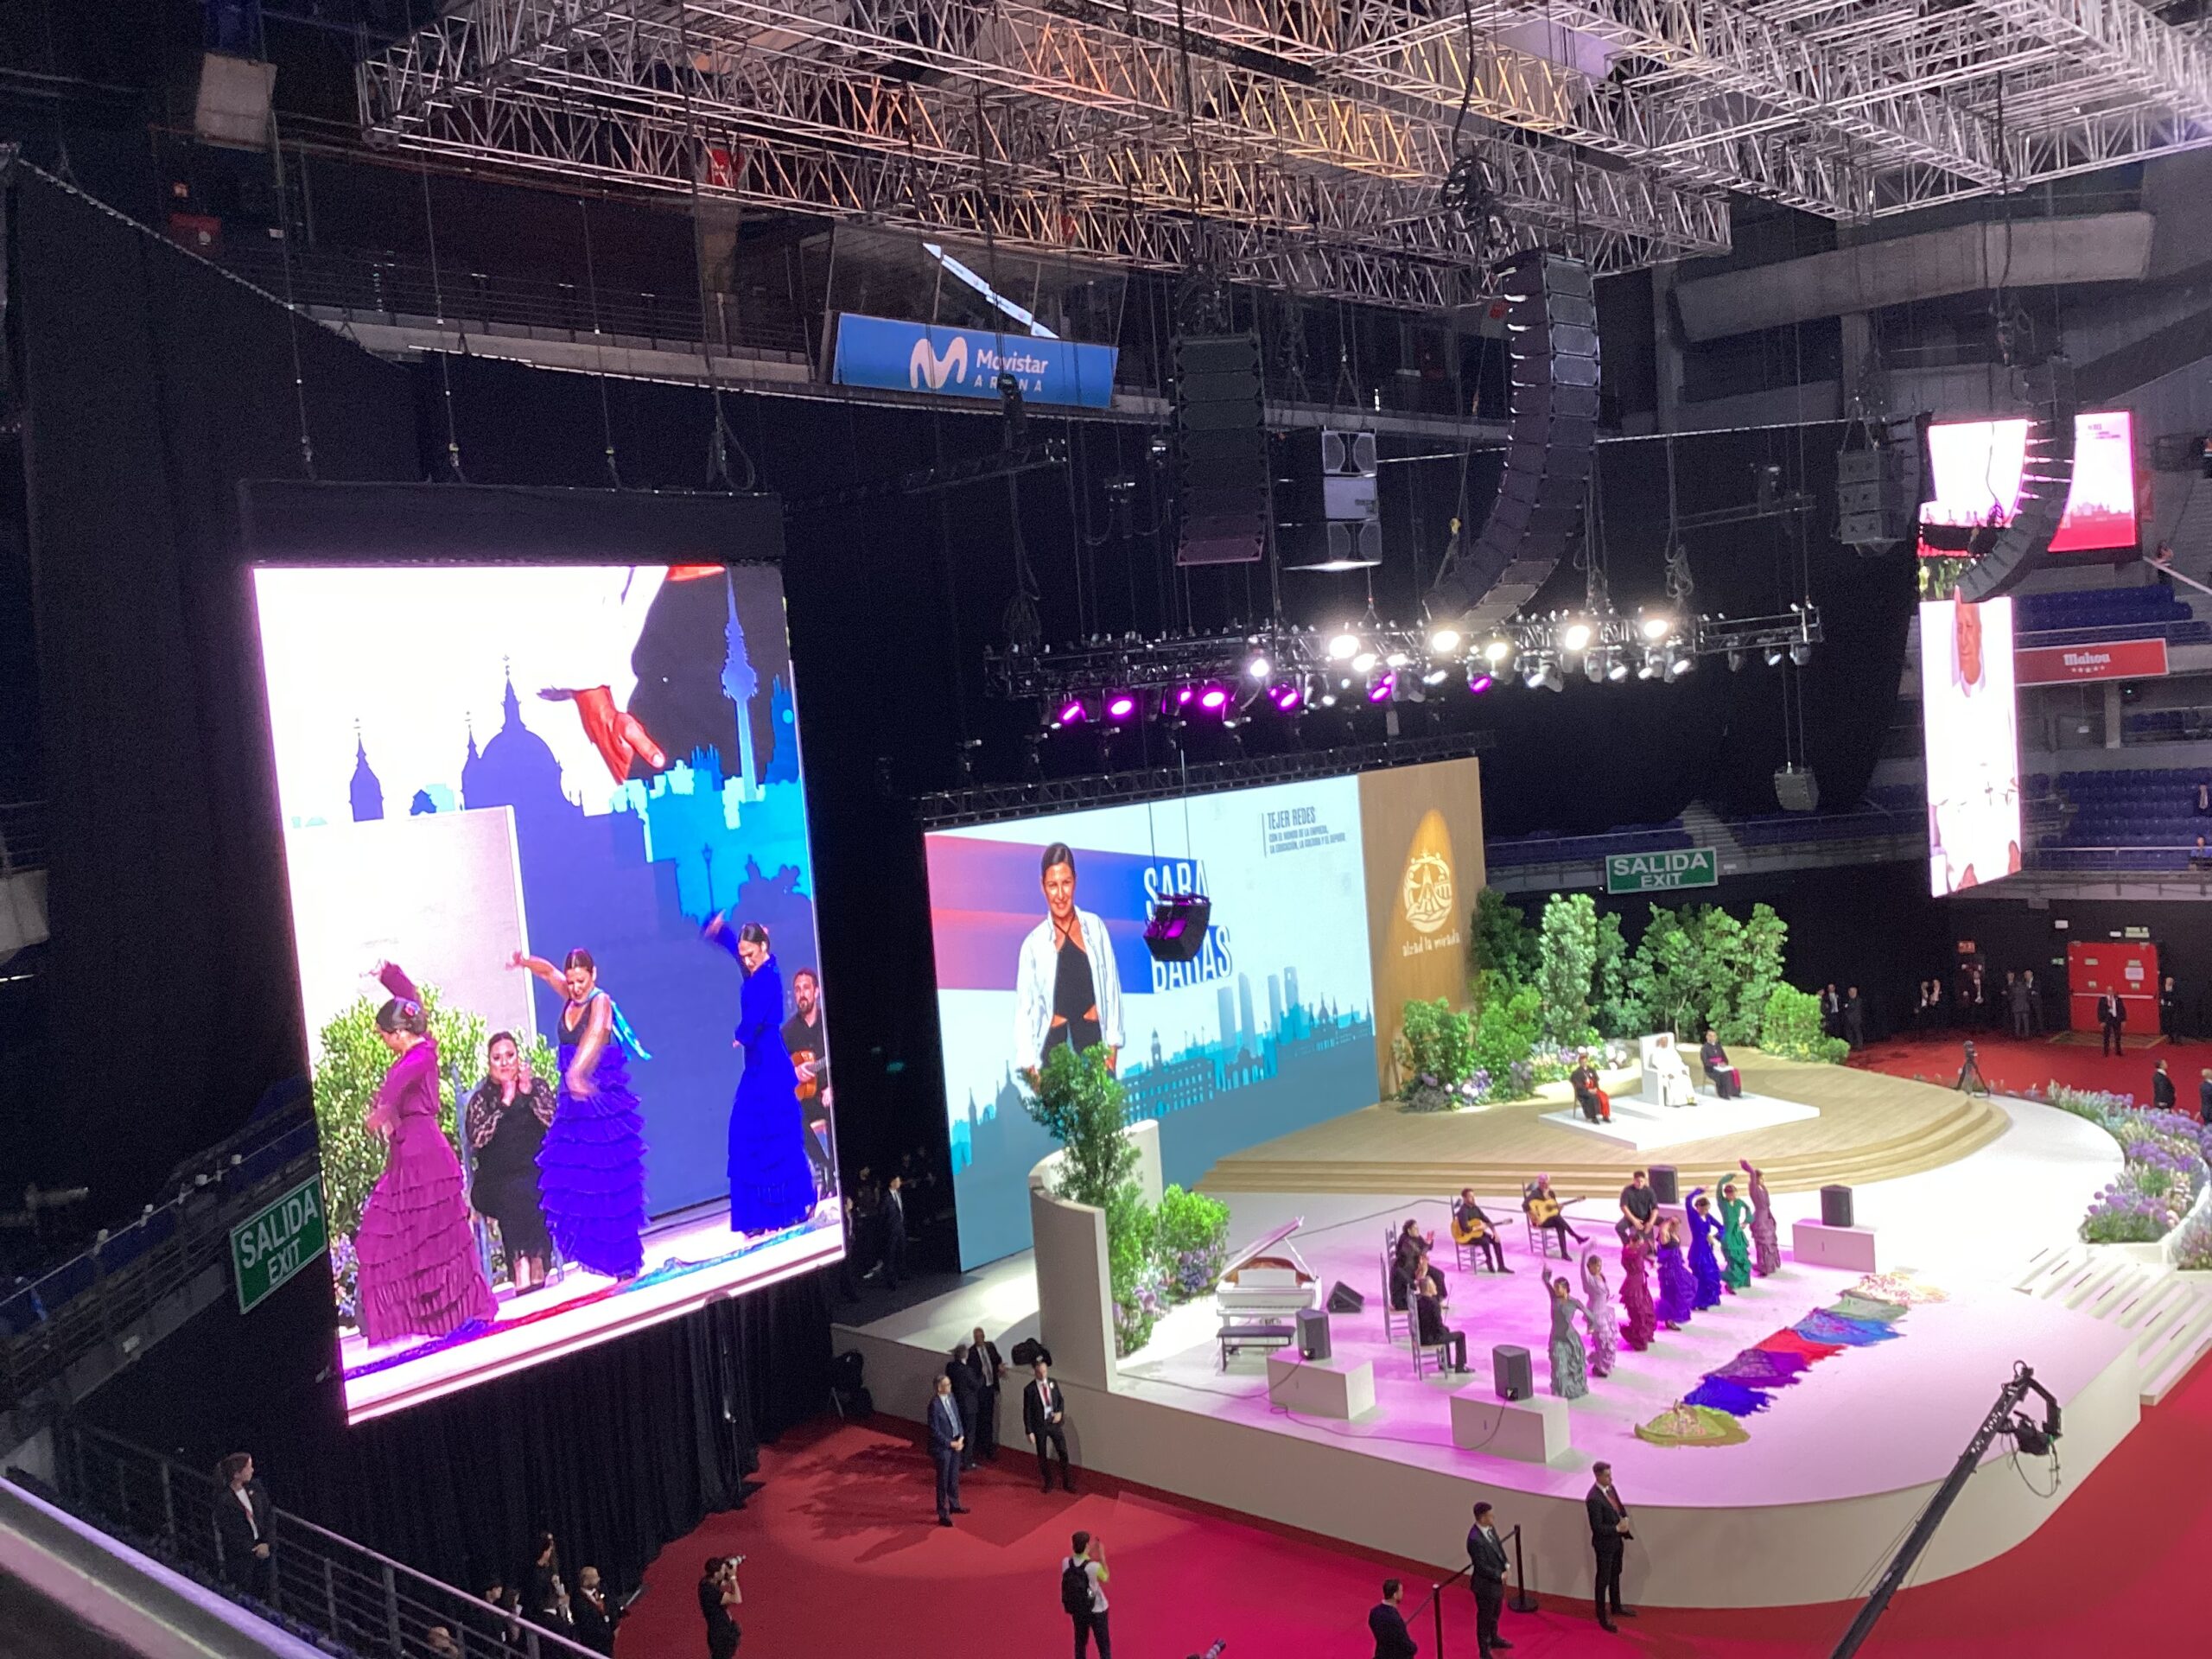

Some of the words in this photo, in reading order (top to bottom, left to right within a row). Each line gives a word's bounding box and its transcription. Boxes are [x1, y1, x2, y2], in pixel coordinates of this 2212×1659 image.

[976, 349, 1048, 374] Movistar
[974, 376, 1042, 392] ARNA
[2063, 652, 2111, 665] Mahou
[1267, 810, 1290, 830] TEJER
[1292, 806, 1316, 826] REDES
[1613, 853, 1708, 876] SALIDA
[1641, 872, 1682, 887] EXIT
[240, 1189, 318, 1269] SALIDA
[267, 1237, 301, 1286] EXIT
